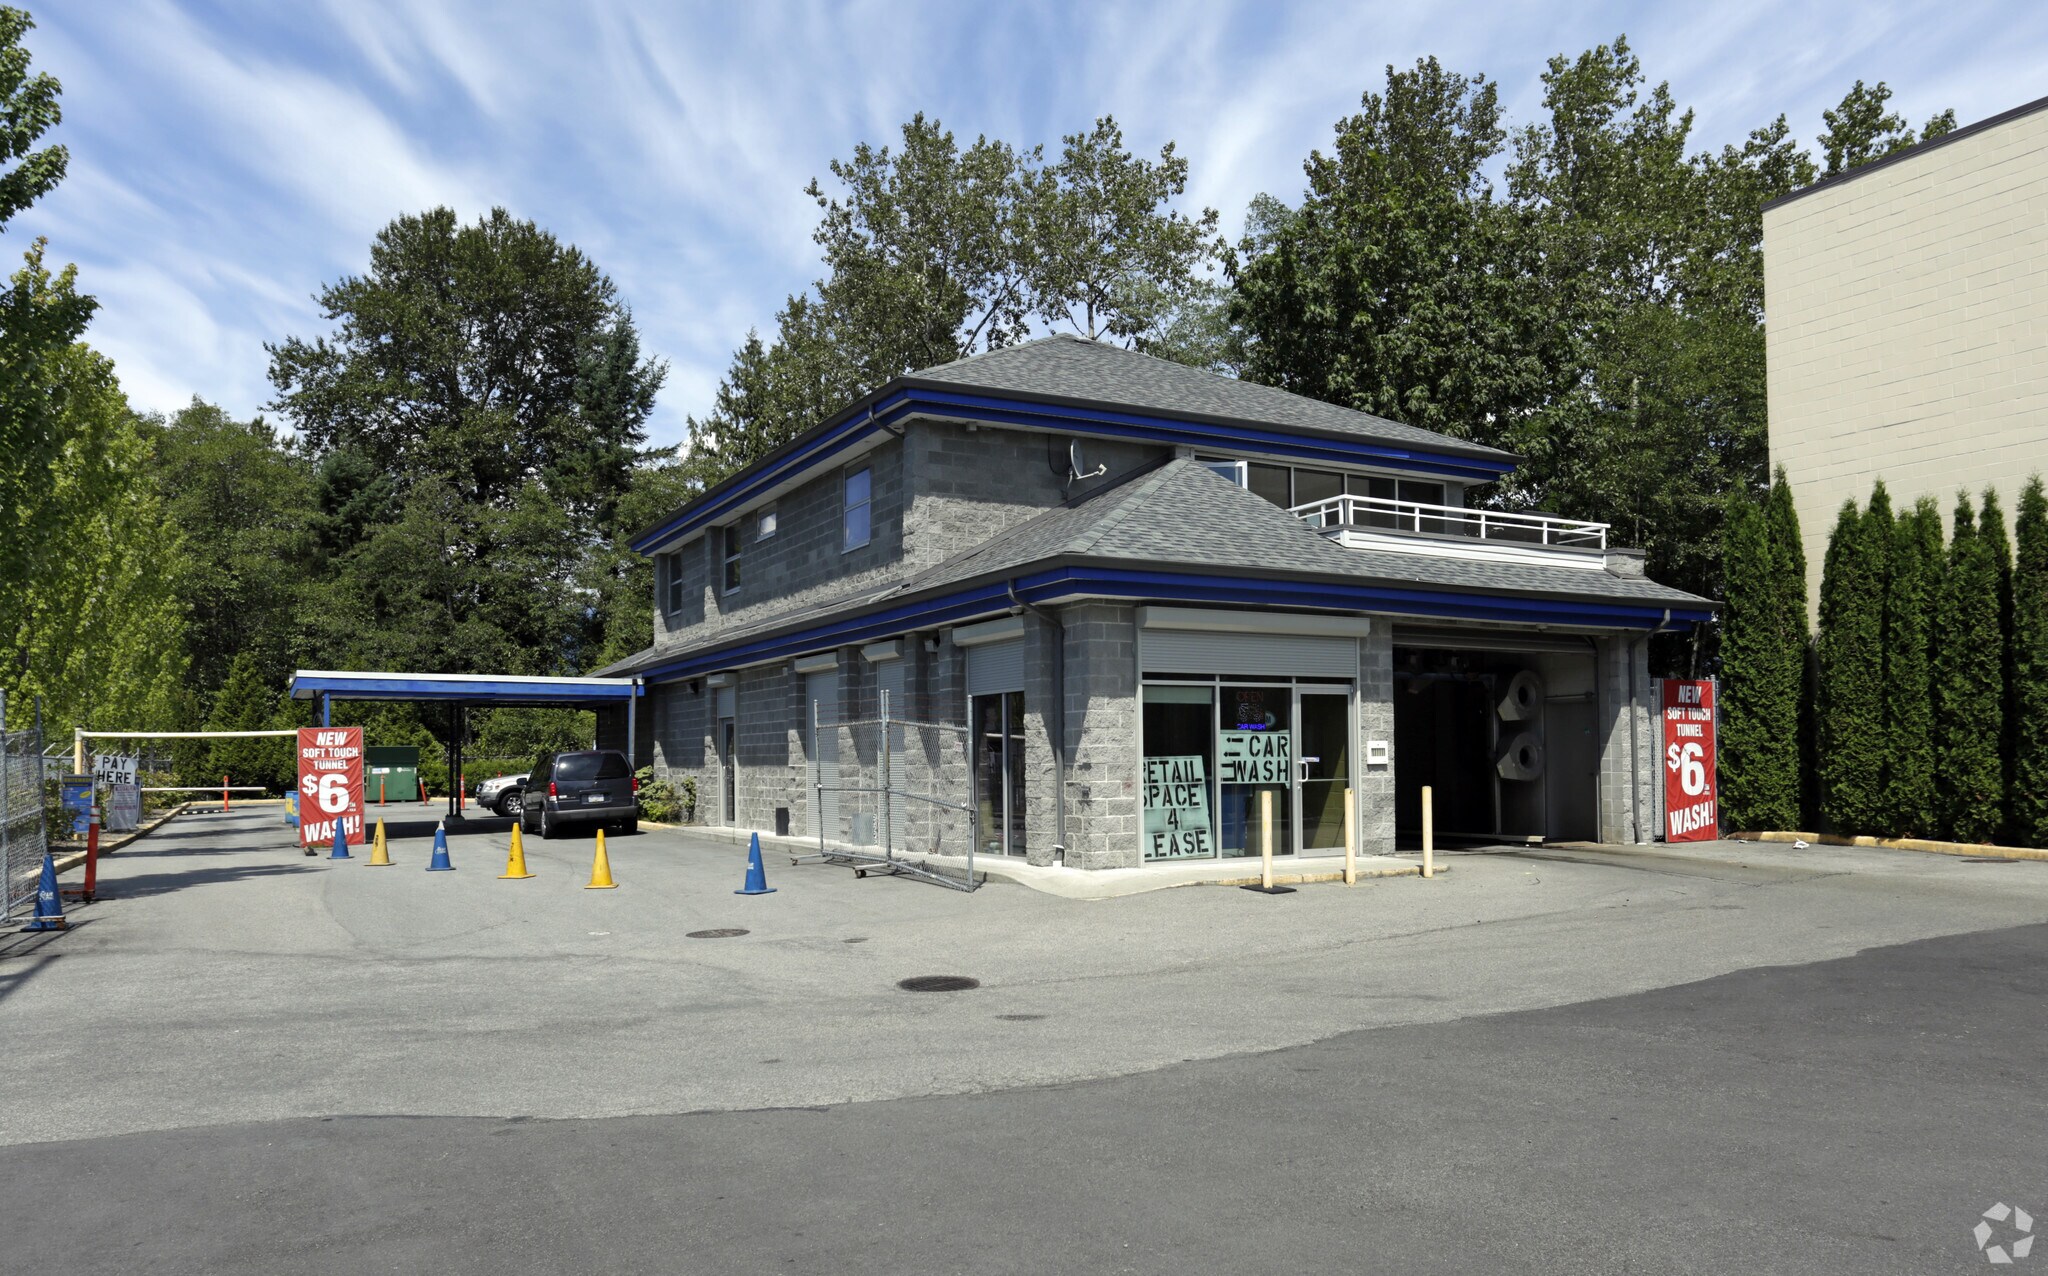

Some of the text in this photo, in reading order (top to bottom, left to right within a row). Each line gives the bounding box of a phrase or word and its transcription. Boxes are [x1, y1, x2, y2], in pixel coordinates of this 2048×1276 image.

[1678, 685, 1702, 704] NEW
[1667, 707, 1711, 721] SOFT TOUCH
[1676, 724, 1703, 737] TUNNEL
[316, 732, 347, 746] NEW
[1249, 735, 1288, 758] CAR
[302, 747, 359, 758] SOFT TOUCH
[102, 756, 128, 770] PAY
[313, 760, 349, 770] TUNNEL
[1233, 760, 1289, 782] WASH
[1667, 742, 1705, 796] $6
[96, 770, 132, 784] HERE
[302, 773, 350, 814] $6
[1167, 808, 1179, 830] 4
[1669, 801, 1714, 836] WASH!
